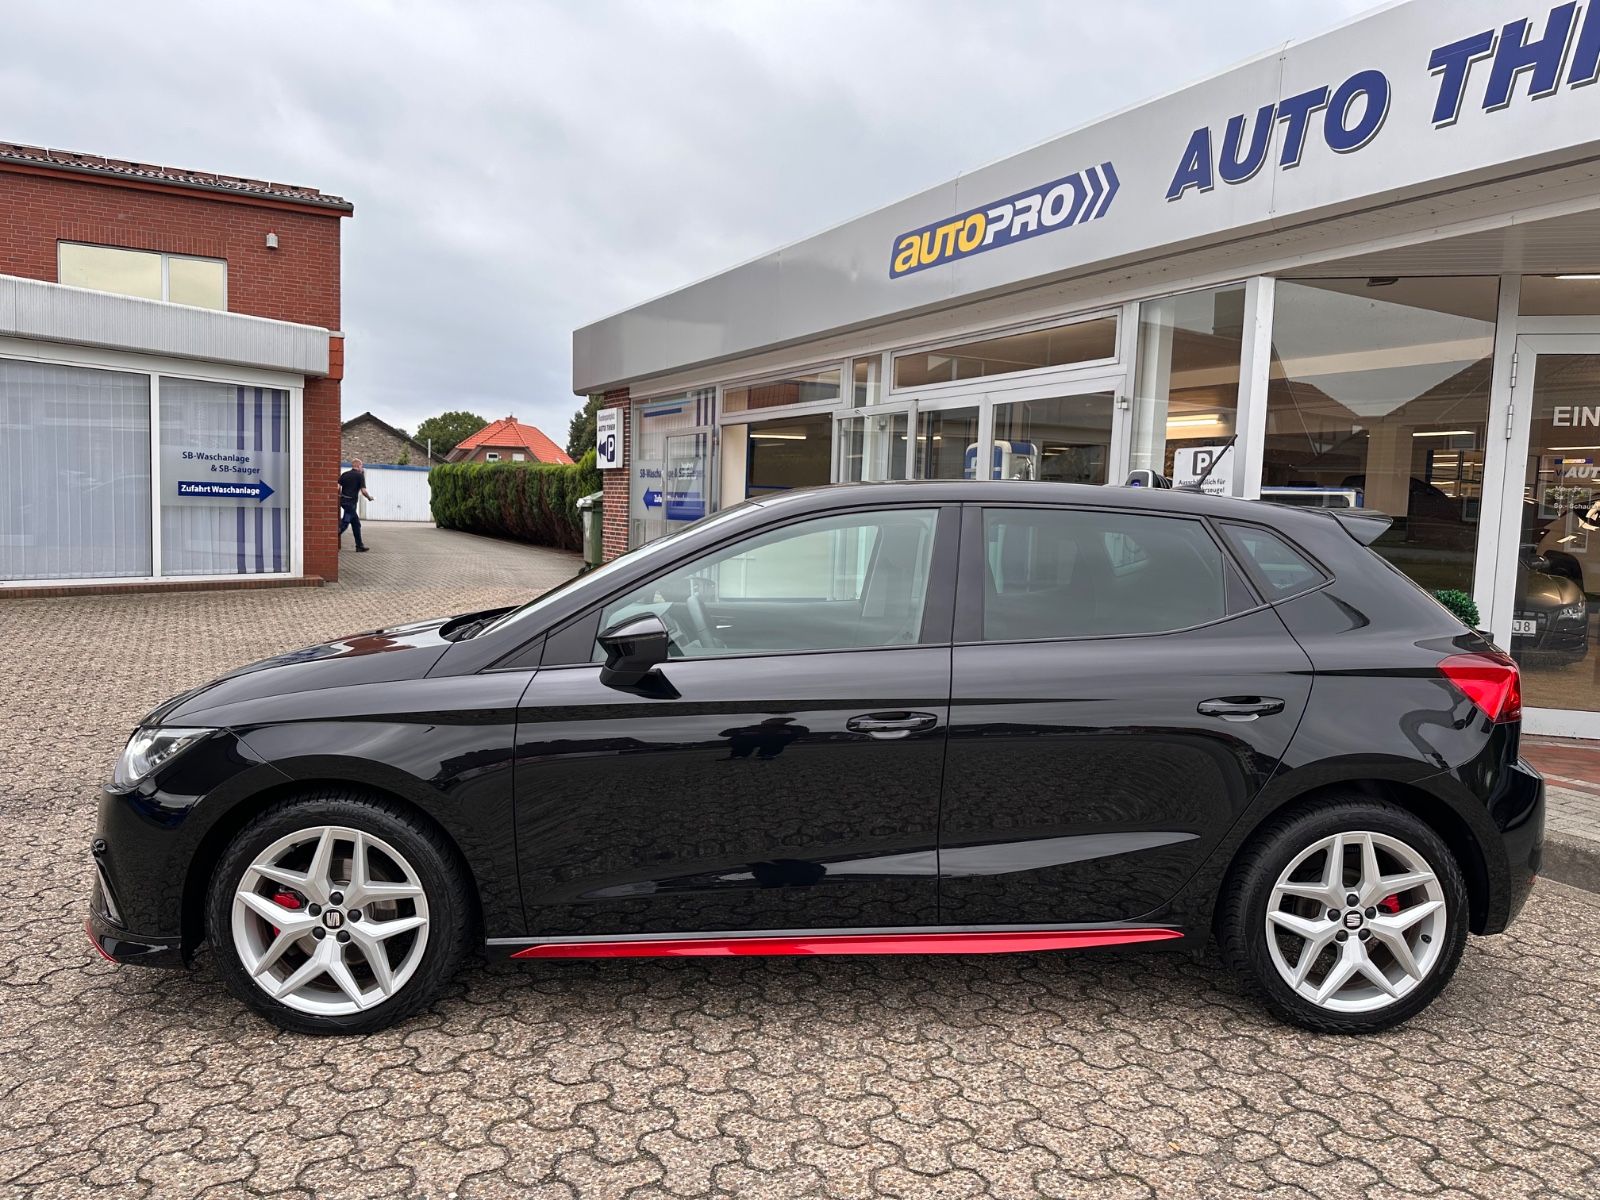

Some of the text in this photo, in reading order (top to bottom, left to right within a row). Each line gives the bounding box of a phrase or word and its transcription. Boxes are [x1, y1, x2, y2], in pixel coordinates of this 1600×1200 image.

[1165, 69, 1391, 202] AUTO
[1553, 406, 1600, 427] EIN
[182, 451, 250, 464] SB-Waschanlage
[1196, 452, 1211, 474] P
[210, 464, 260, 476] & SB-Sauger
[181, 484, 260, 496] Zufahrt Waschanlage
